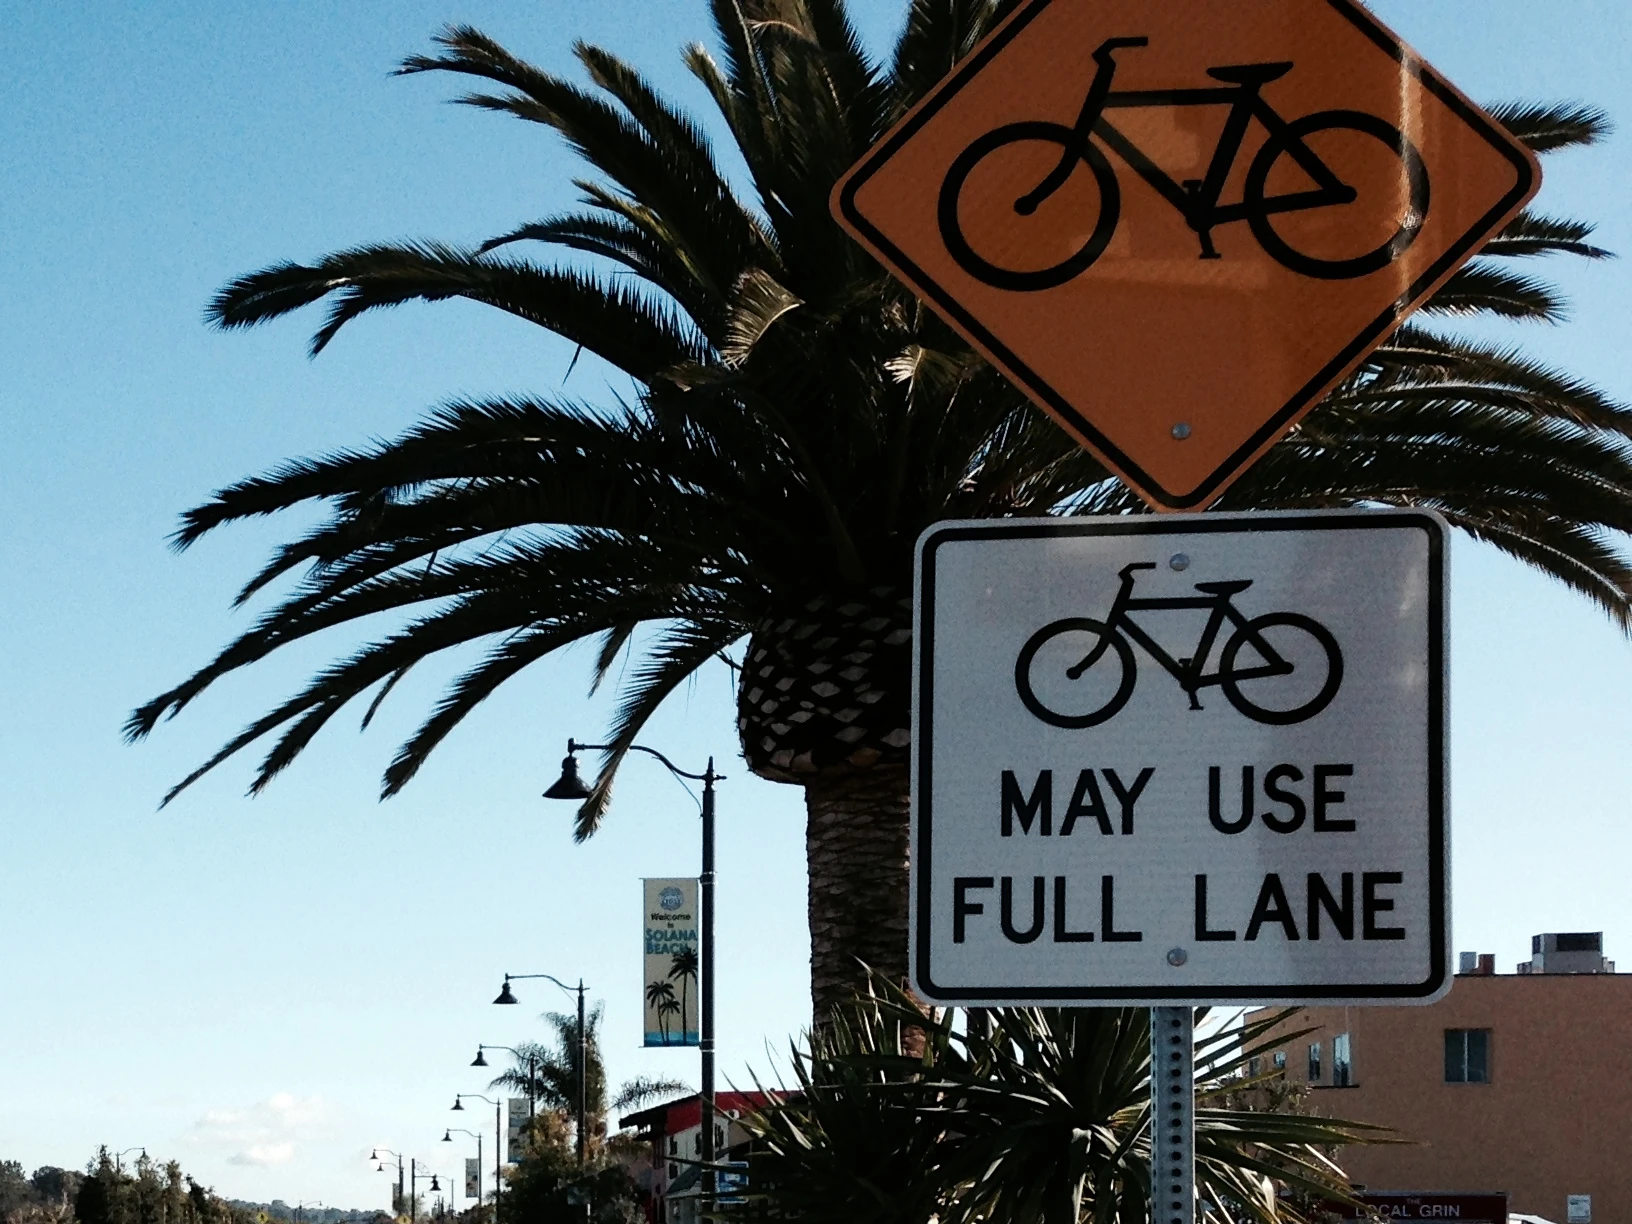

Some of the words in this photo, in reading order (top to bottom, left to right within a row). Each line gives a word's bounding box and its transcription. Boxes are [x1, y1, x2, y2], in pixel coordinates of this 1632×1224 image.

[999, 766, 1156, 838] MAY
[1207, 763, 1357, 836] USE
[952, 874, 1143, 945] FULL
[1193, 871, 1406, 943] LANE
[650, 912, 691, 921] Welcome
[645, 928, 698, 942] SOLANA
[646, 942, 689, 954] BEACH
[1355, 1204, 1412, 1217] LOCAL
[1419, 1204, 1460, 1217] GRIN
